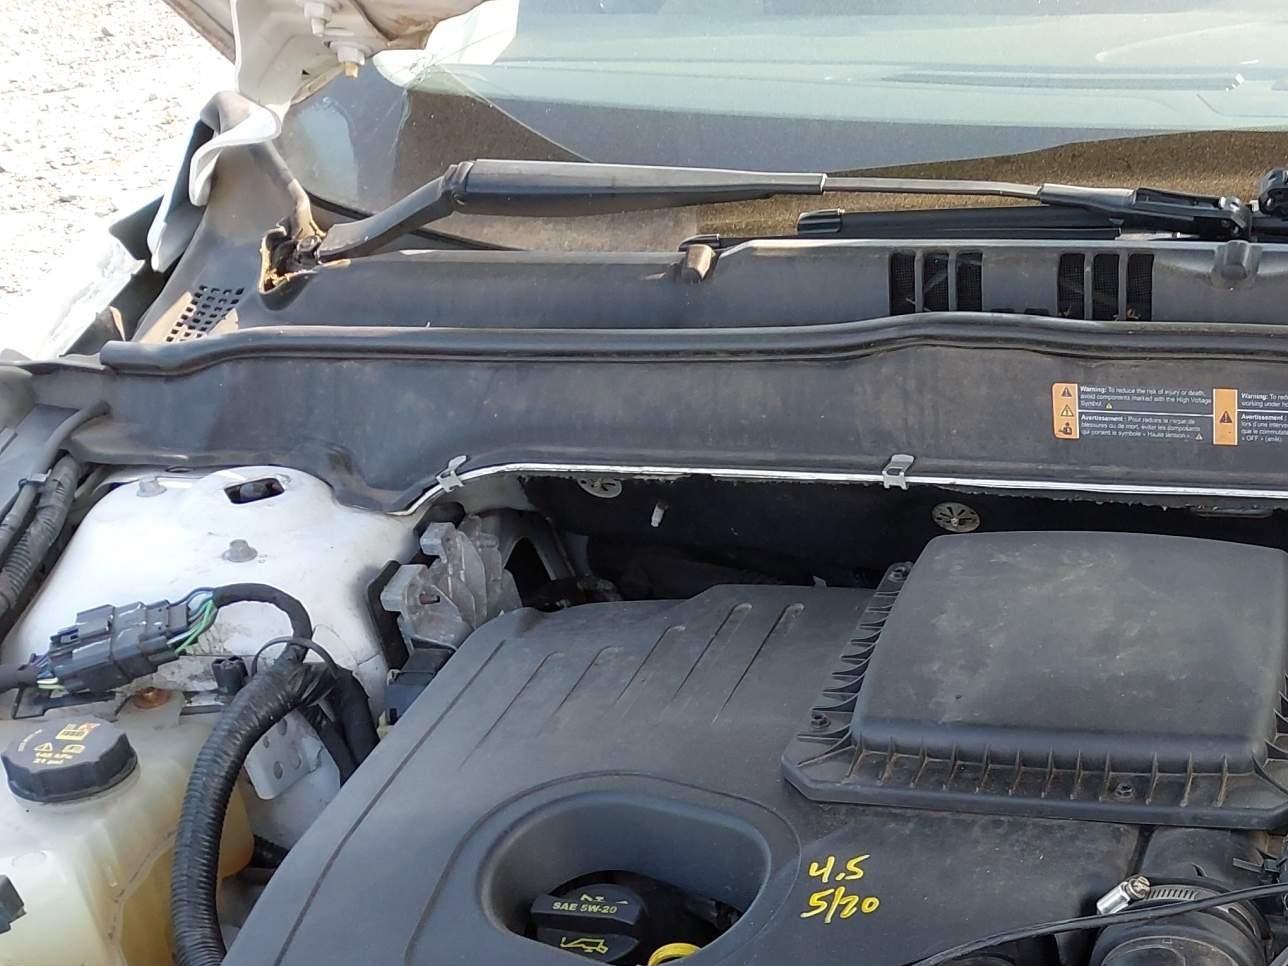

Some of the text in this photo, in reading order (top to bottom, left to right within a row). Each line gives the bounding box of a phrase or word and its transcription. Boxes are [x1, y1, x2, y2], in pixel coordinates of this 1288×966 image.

[1080, 386, 1106, 394] Warning:
[1241, 393, 1268, 401] Warning:
[808, 854, 871, 883] 4.5
[552, 902, 618, 914] SAE 5W-20
[799, 886, 880, 924] 5/20
